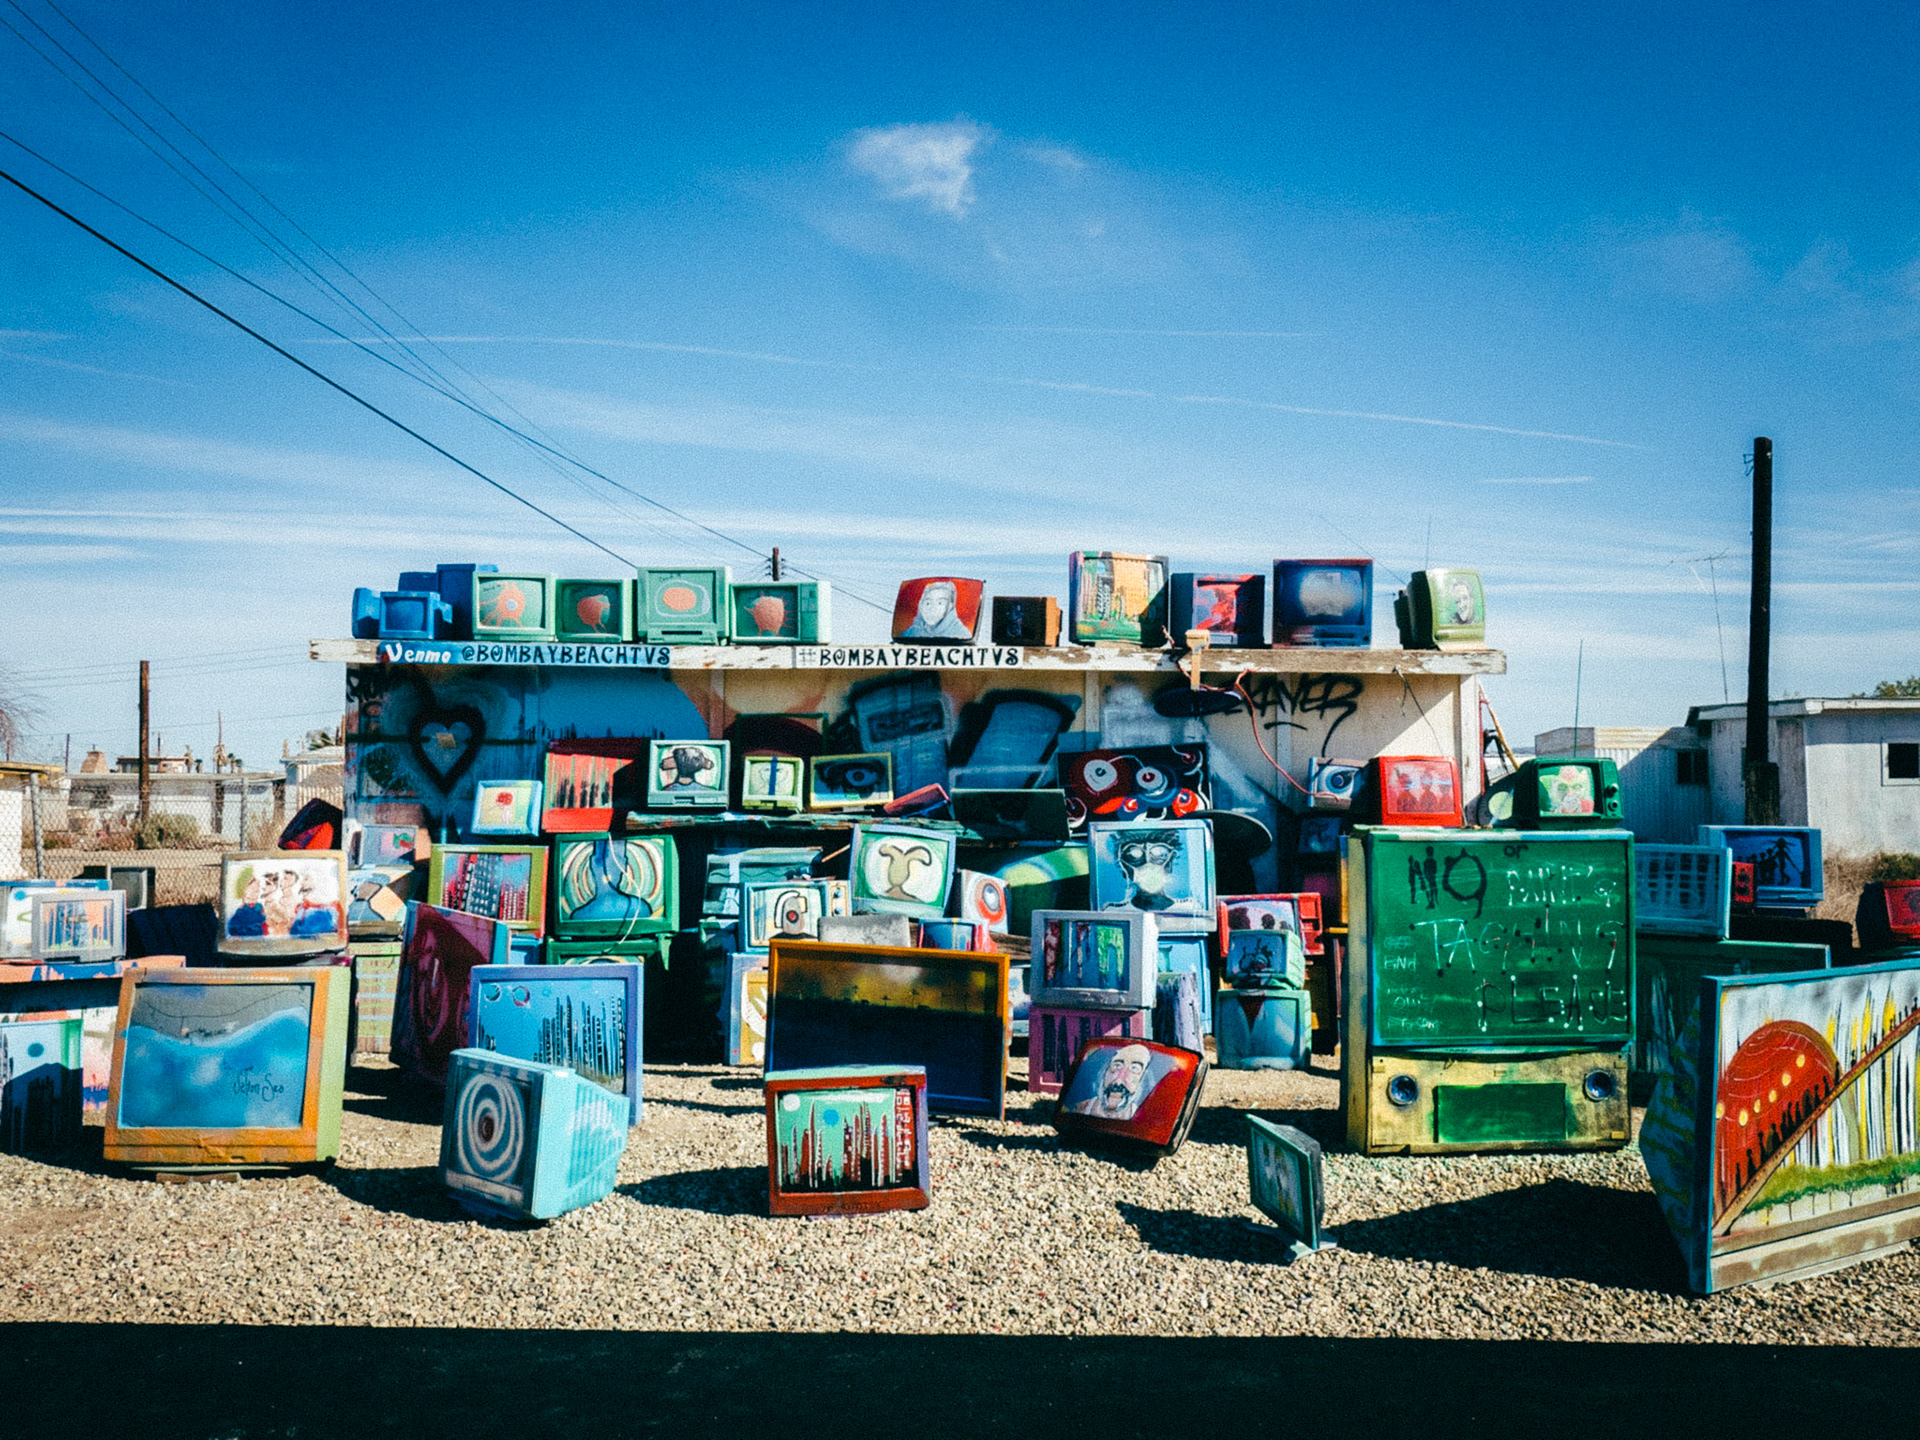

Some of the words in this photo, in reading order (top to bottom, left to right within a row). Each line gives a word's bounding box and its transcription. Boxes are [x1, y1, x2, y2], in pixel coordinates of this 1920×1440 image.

[384, 642, 451, 664] Venmo
[462, 645, 671, 665] @BOMBAYBEACHTVS
[798, 647, 1019, 667] #BOMBAYBEACHTVS
[1503, 845, 1529, 858] or
